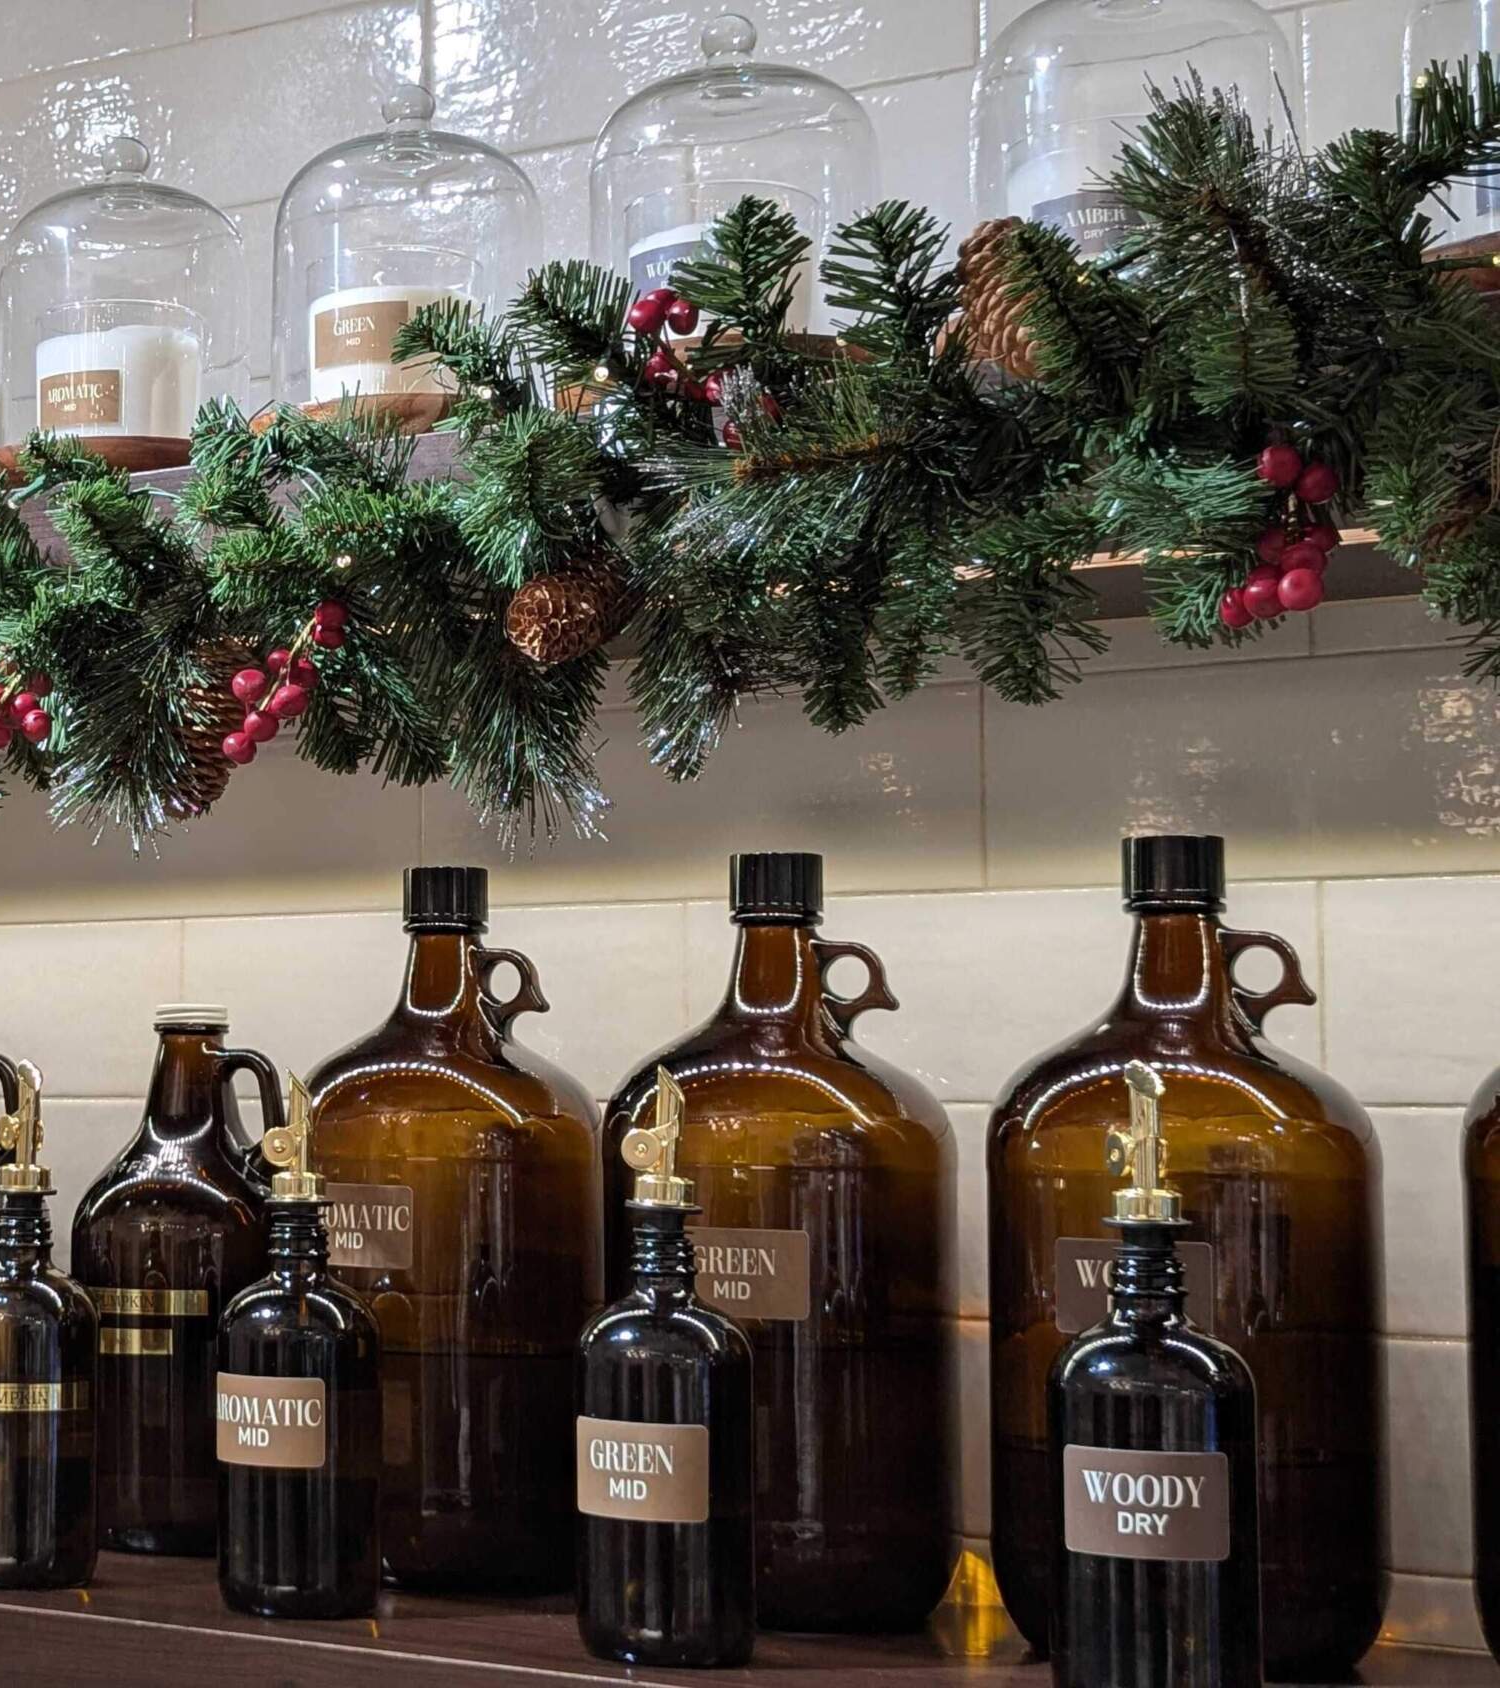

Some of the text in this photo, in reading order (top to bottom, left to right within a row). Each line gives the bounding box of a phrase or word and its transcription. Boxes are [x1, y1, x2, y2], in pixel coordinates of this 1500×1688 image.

[1065, 208, 1126, 227] AMBER
[333, 315, 375, 336] GREEN
[335, 1231, 364, 1249] MID
[694, 1245, 776, 1276] GREEN
[713, 1280, 751, 1300] MID
[238, 1426, 269, 1447] MID
[590, 1438, 675, 1475] GREEN
[608, 1477, 648, 1501] MID
[1081, 1469, 1206, 1510] WOODY
[1116, 1510, 1169, 1536] DRY
